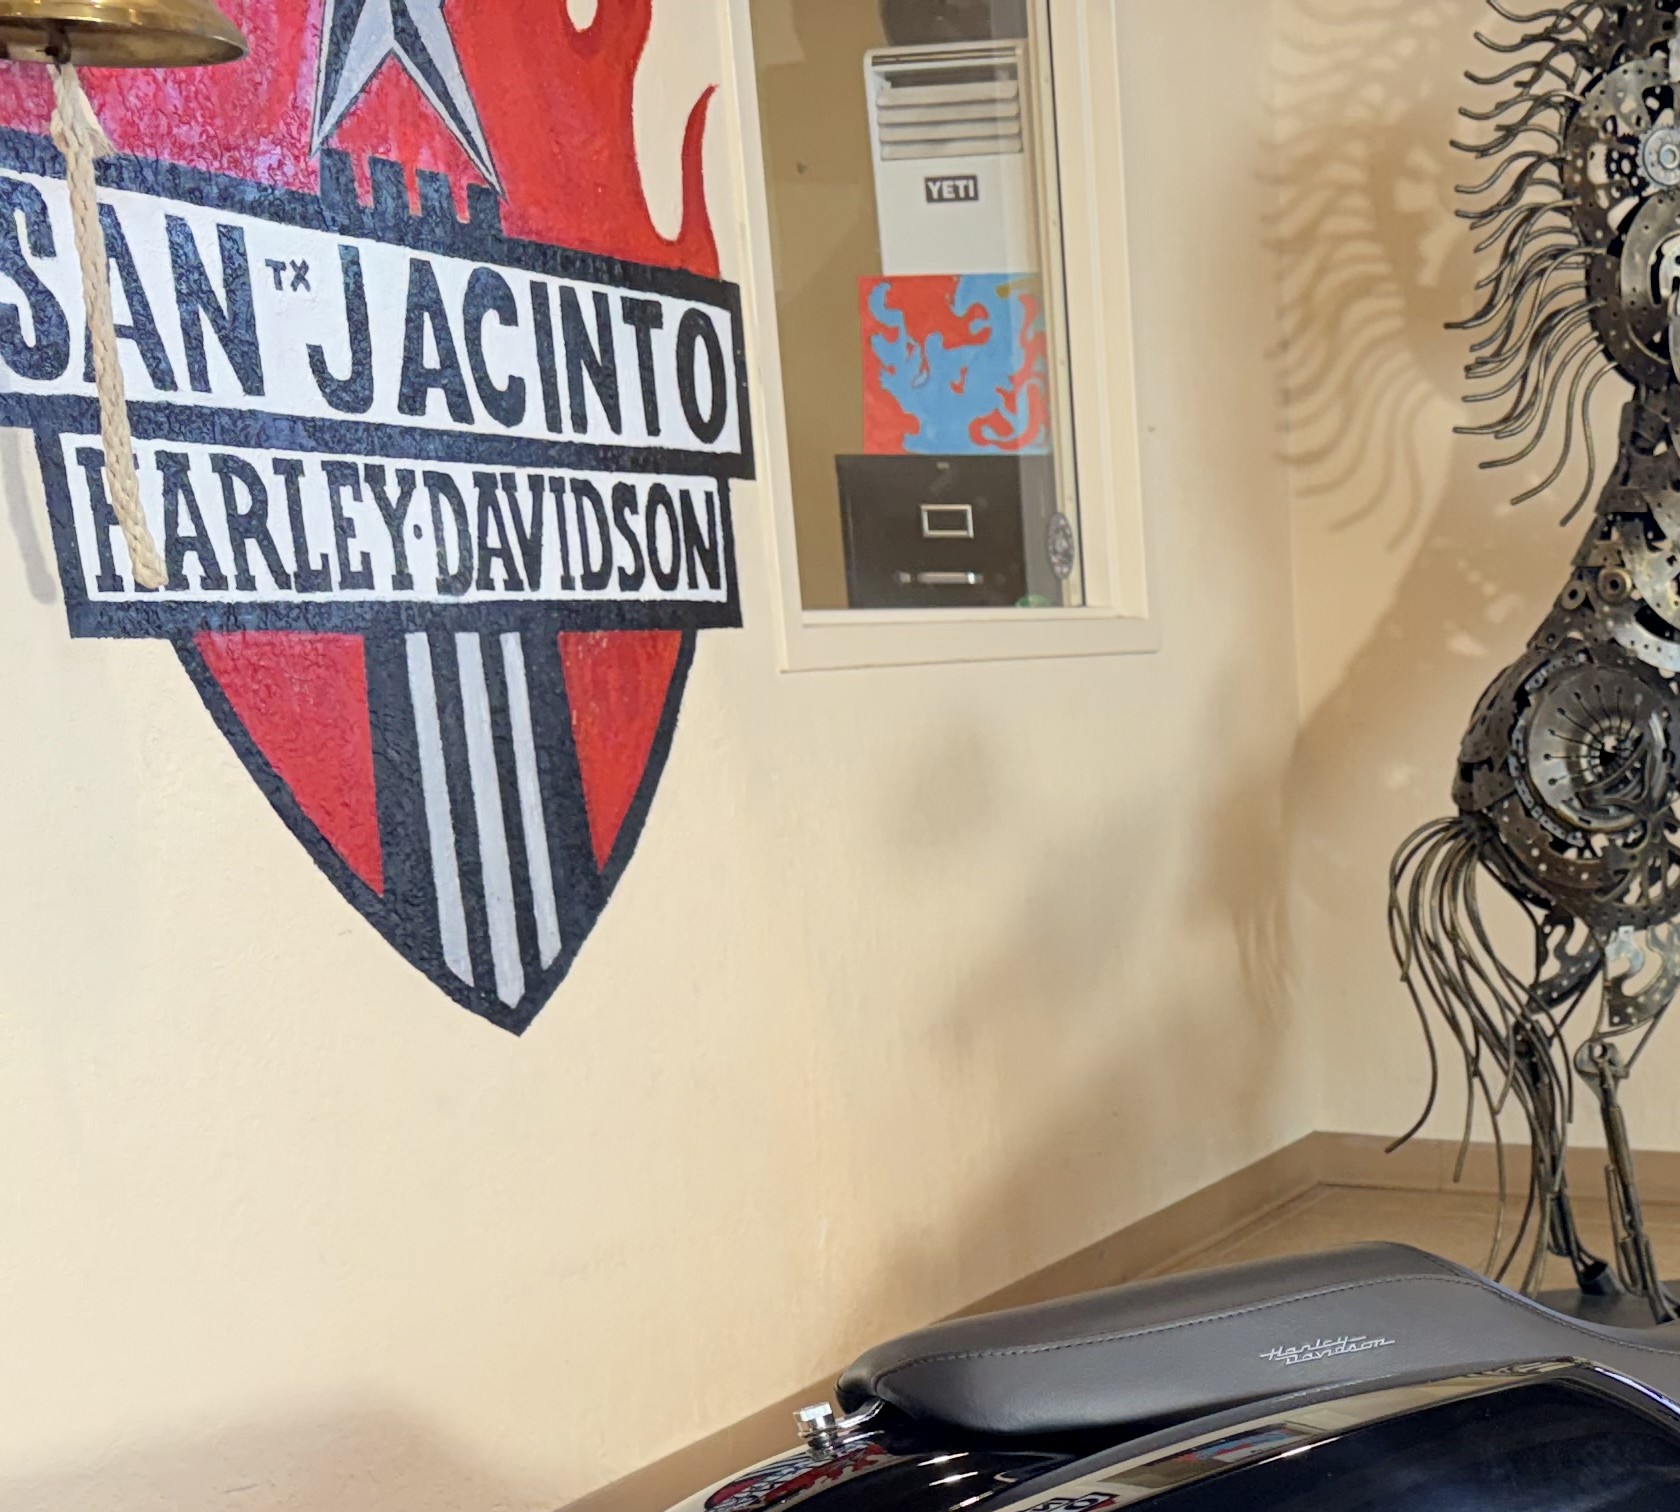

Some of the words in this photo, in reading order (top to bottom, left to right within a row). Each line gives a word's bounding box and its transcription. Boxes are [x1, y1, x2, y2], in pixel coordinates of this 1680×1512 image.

[926, 179, 975, 199] YETI
[0, 176, 265, 397] SAN
[265, 258, 311, 293] TX
[306, 245, 729, 444] JACINTO
